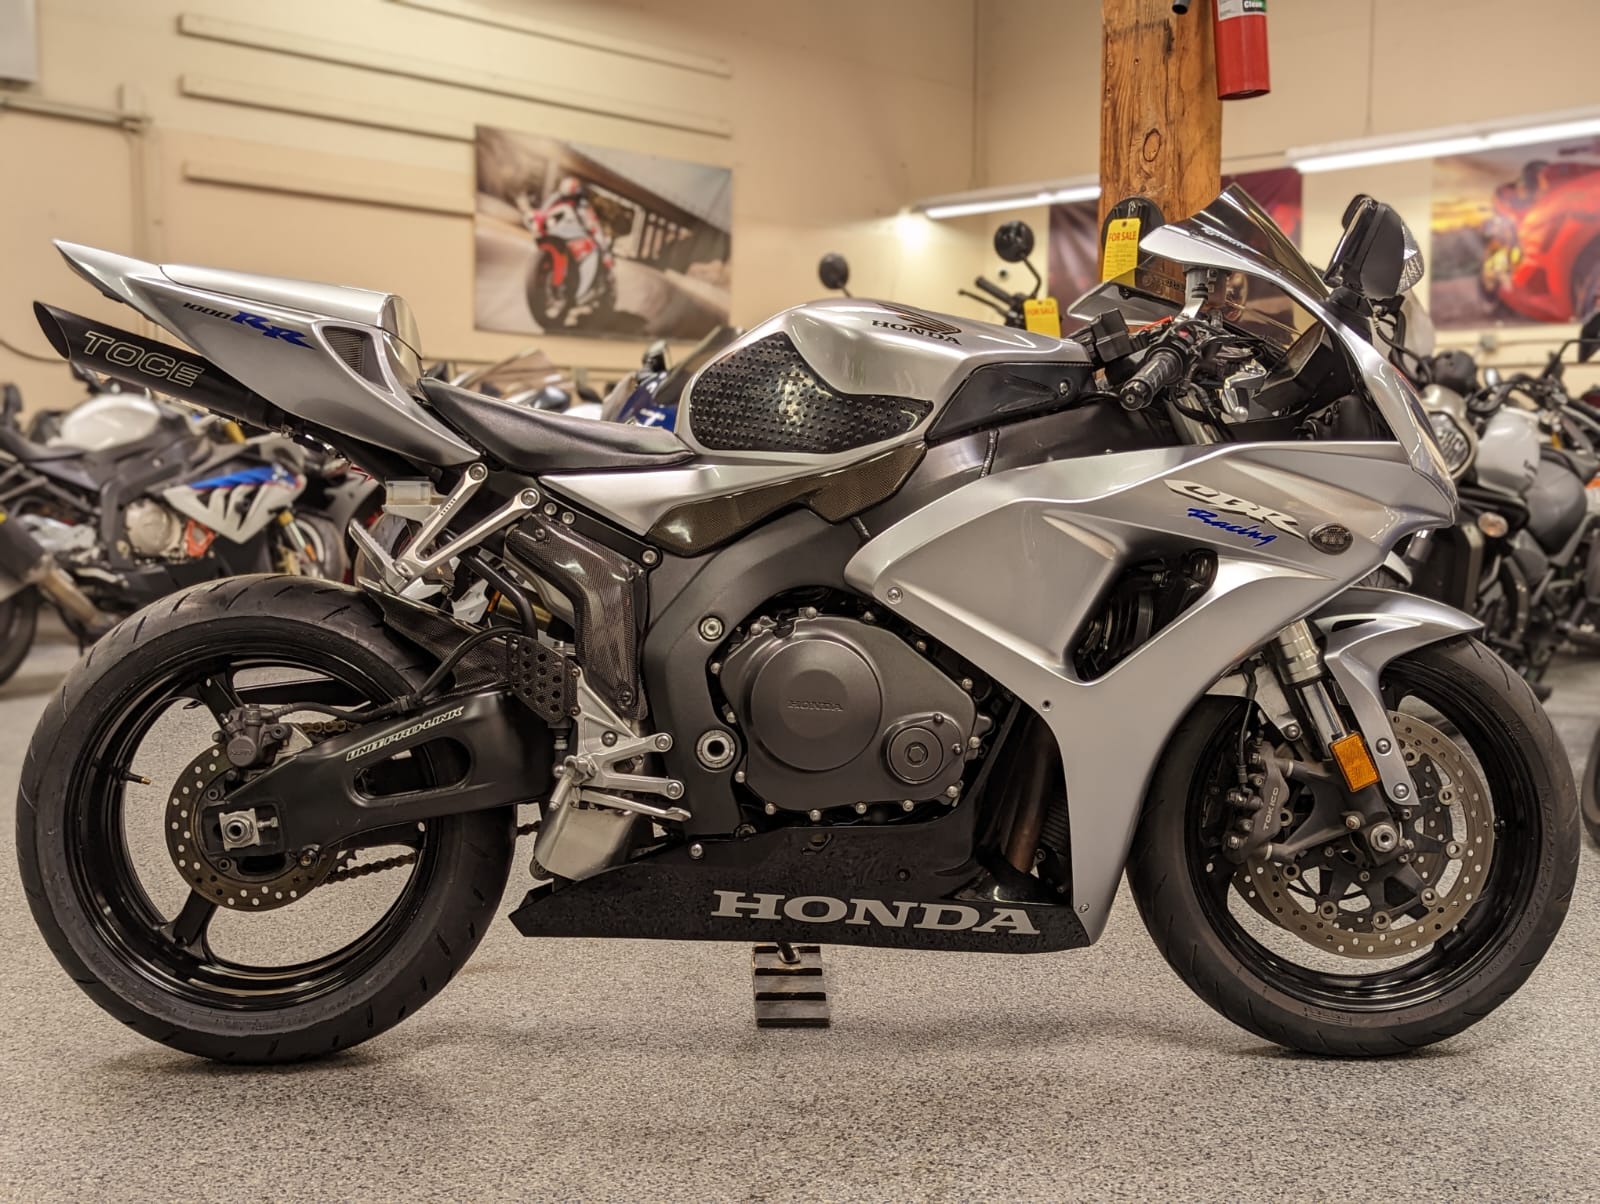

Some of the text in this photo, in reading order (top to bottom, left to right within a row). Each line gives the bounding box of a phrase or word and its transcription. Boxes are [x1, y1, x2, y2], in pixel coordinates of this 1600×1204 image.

[1108, 231, 1137, 241] FOR SALE
[872, 319, 962, 346] HONDA
[84, 330, 205, 388] TOCE
[1163, 479, 1306, 541] CBR
[1187, 507, 1278, 547] Racing
[787, 700, 843, 712] HONDA
[345, 738, 385, 762] UNIT
[1263, 787, 1279, 831] TOKICO
[711, 890, 1041, 935] HONDA
